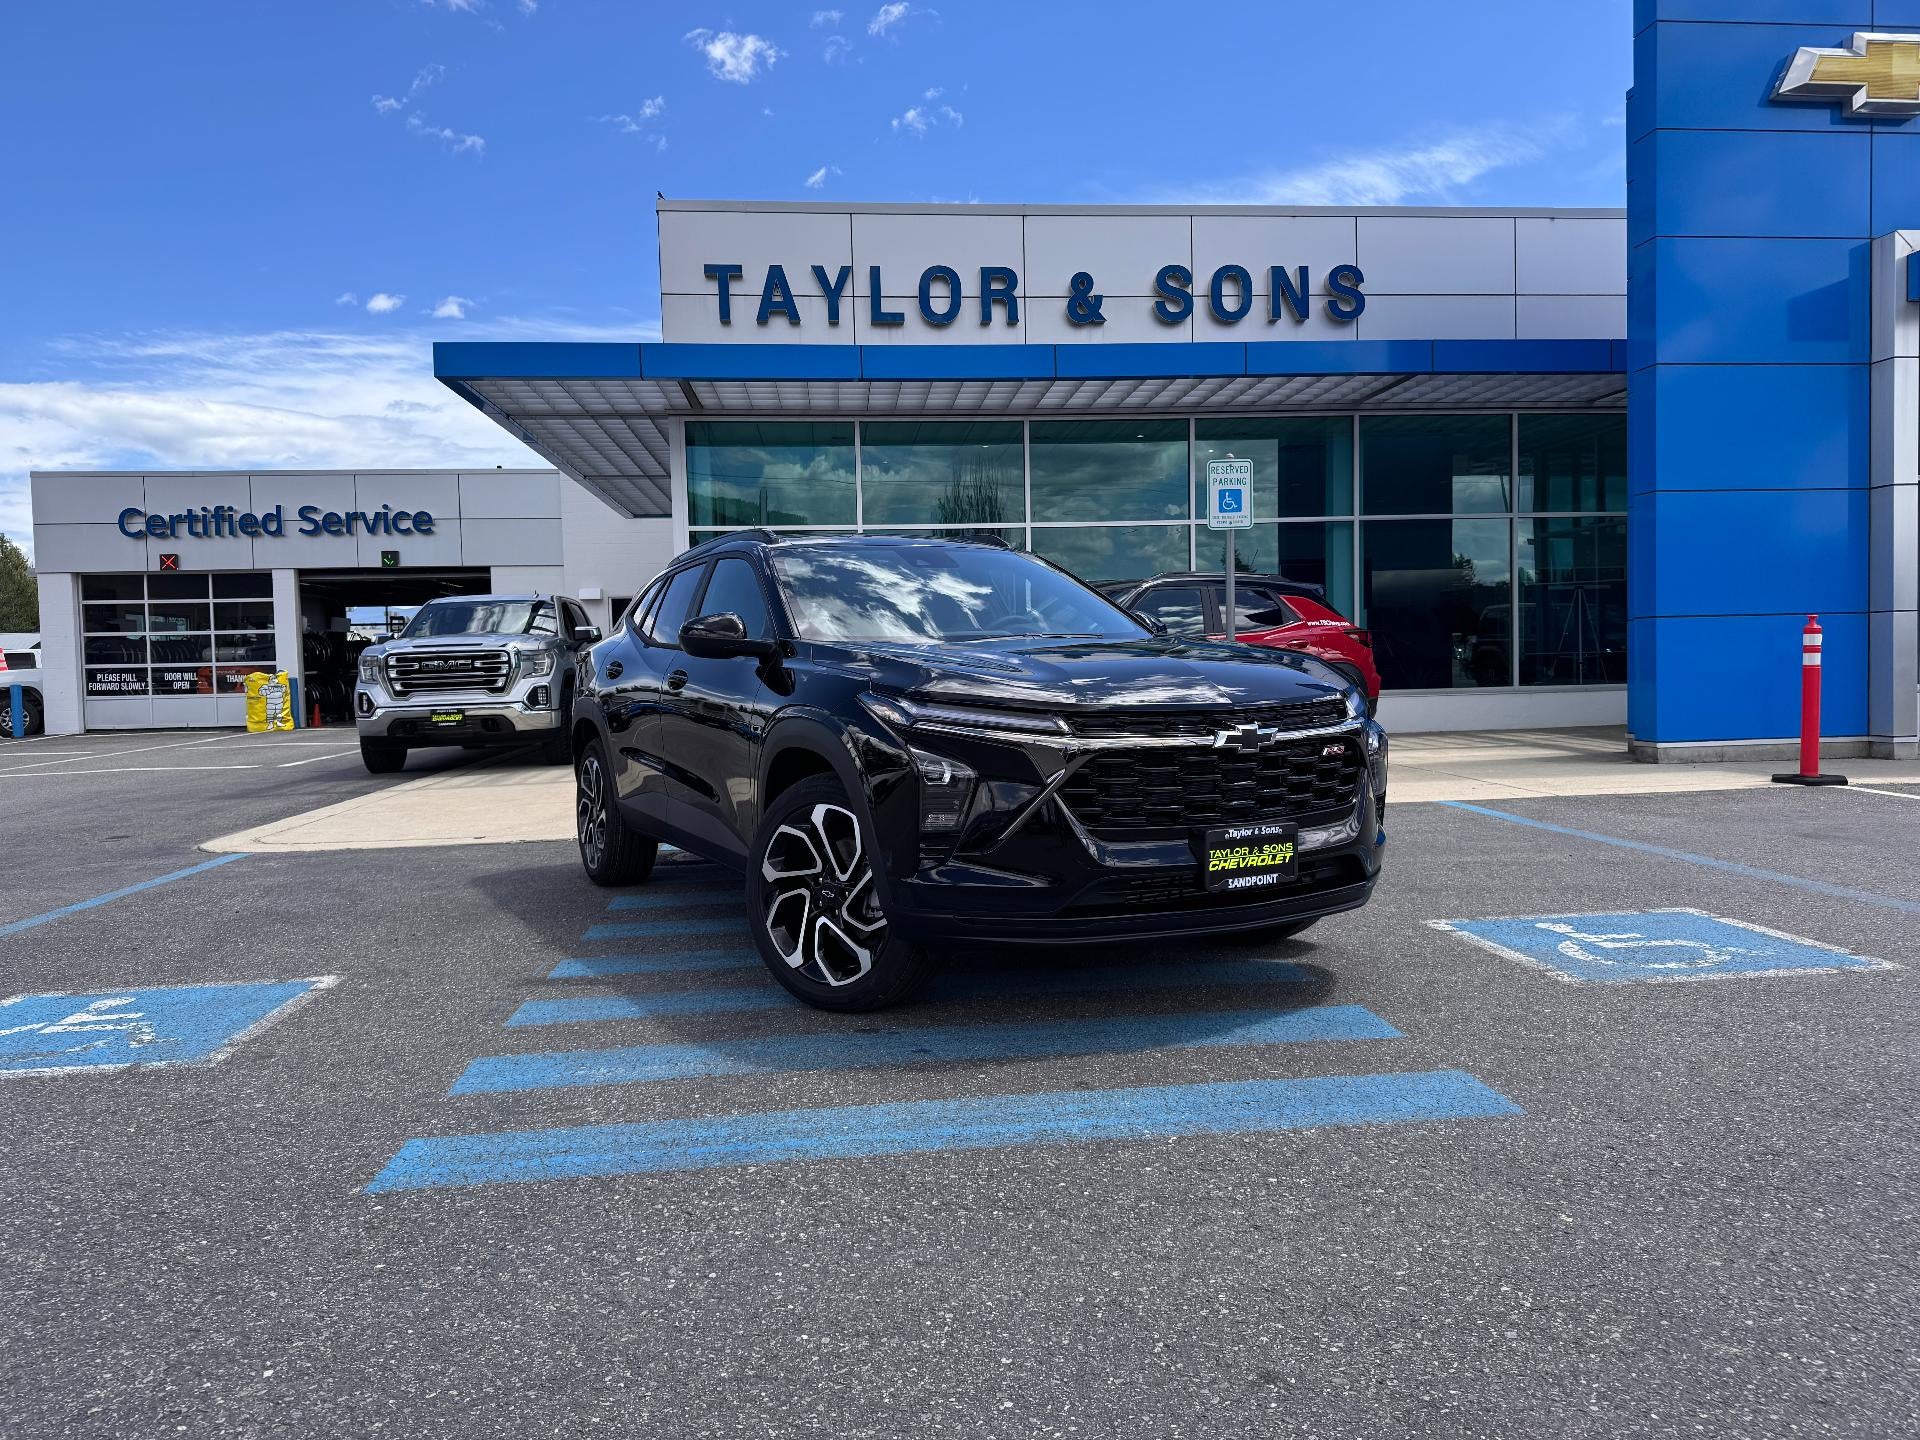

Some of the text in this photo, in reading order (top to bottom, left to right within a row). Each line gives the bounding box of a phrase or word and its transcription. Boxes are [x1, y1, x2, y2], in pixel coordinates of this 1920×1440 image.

[703, 263, 1366, 327] TAYLOR & SONS
[1210, 465, 1249, 475] RESERVED
[1212, 477, 1247, 486] PARKING
[117, 503, 435, 538] Certified Service
[421, 659, 472, 671] GMC
[96, 673, 137, 682] PLEASE PULL
[164, 672, 199, 681] DOOR WILL
[88, 681, 146, 691] FORWARD SLOWLY
[172, 681, 190, 690] OPEN
[1228, 828, 1253, 839] Taylor
[1261, 826, 1280, 835] Sons
[1209, 842, 1294, 859] TAYLOR & SONS
[1208, 853, 1294, 872] CHEVROLET
[1228, 873, 1279, 889] SANDPOINT
